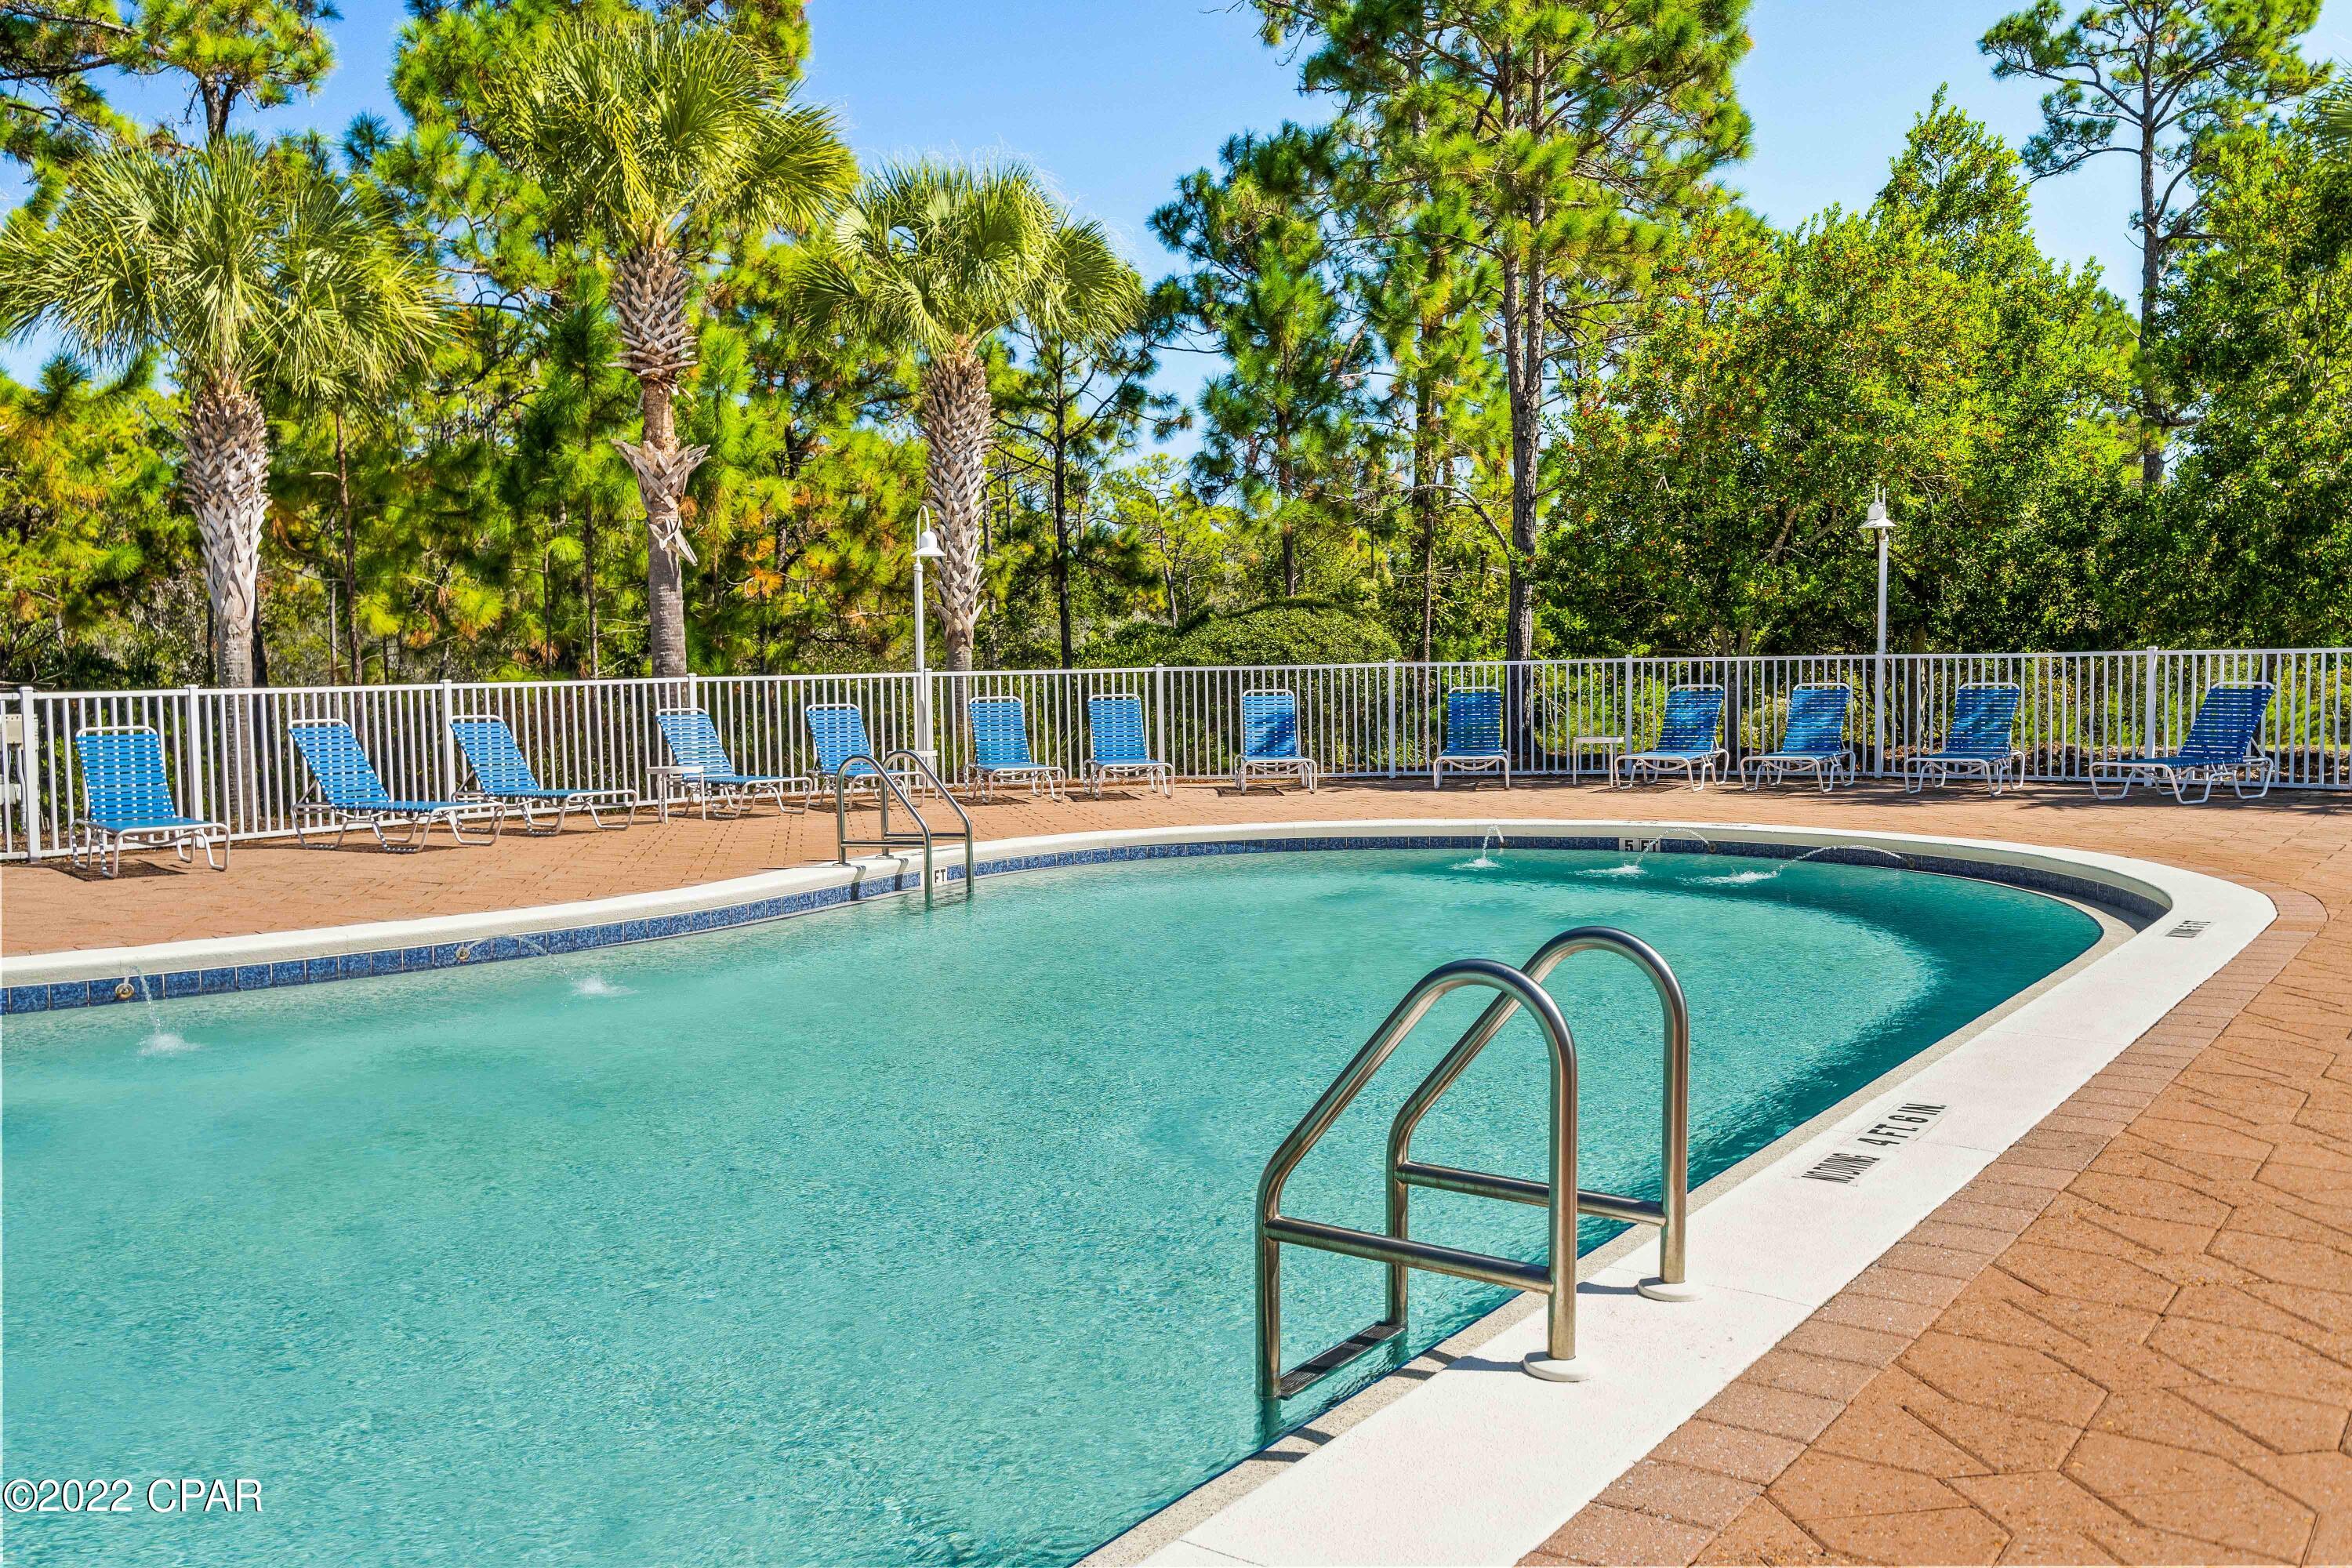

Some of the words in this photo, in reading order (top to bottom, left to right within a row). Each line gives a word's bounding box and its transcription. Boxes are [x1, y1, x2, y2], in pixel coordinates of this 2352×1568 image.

[1625, 840, 1633, 851] 5
[1642, 840, 1658, 851] FT
[935, 869, 946, 883] FT
[1857, 1138, 1900, 1146] 4
[1888, 1115, 1929, 1123] 6
